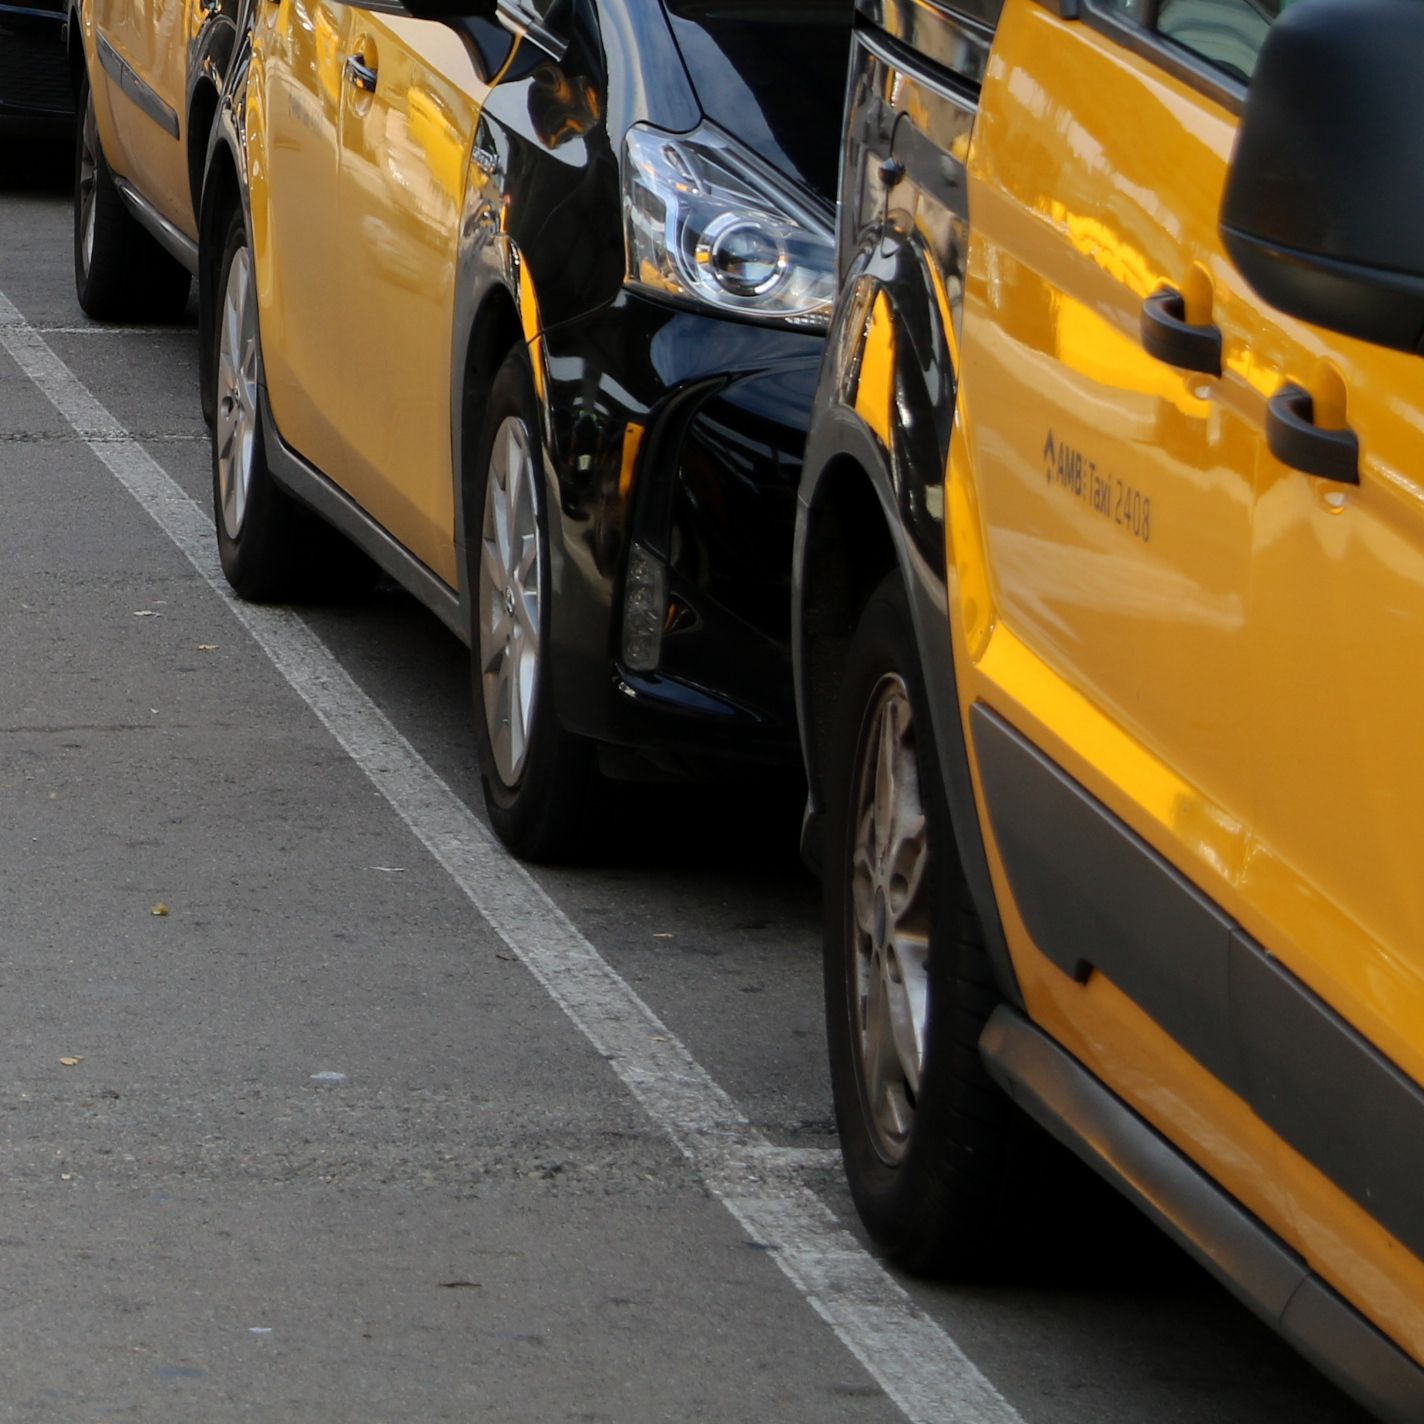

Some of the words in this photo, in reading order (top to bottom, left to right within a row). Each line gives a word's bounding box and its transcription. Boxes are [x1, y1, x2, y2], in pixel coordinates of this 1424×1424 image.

[1056, 441, 1082, 496] AMB
[1089, 462, 1111, 520] Taxi
[1114, 479, 1150, 543] 2408
